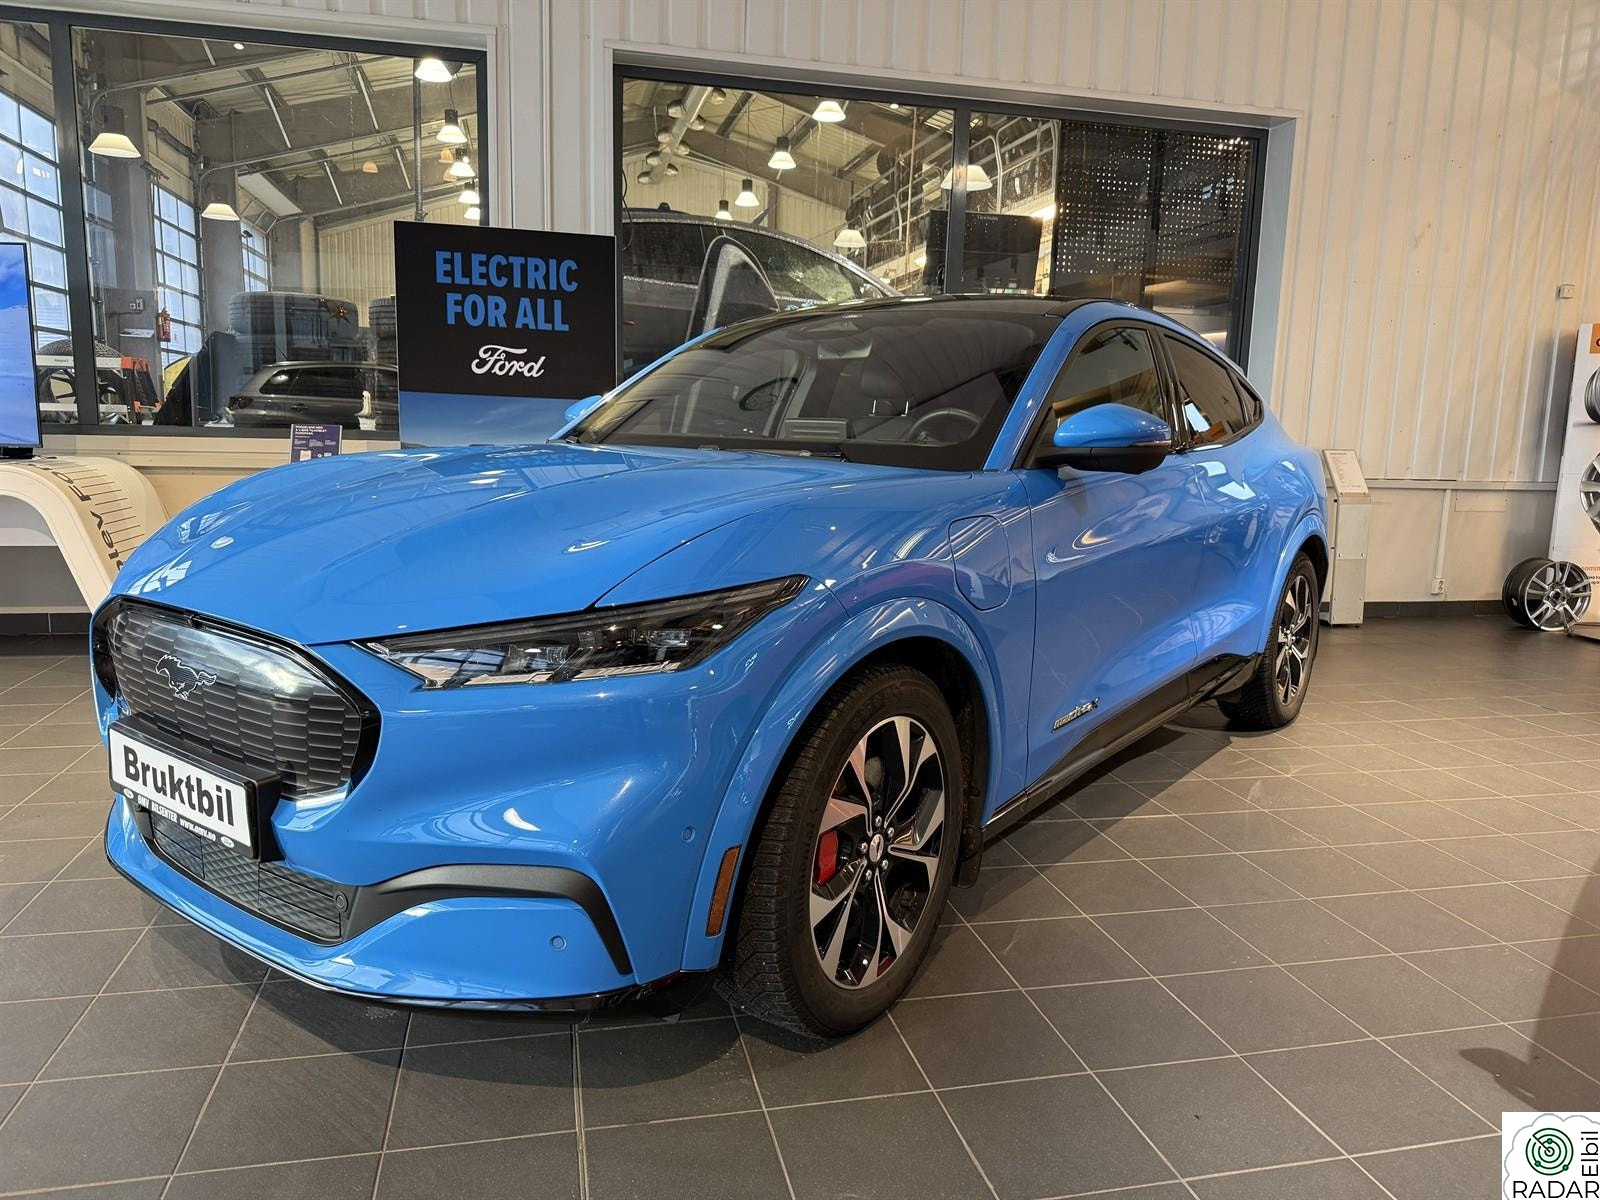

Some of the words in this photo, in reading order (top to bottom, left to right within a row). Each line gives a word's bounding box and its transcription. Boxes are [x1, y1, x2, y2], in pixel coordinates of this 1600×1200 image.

[435, 250, 579, 293] ELECTRIC
[446, 292, 508, 329] FOR
[515, 297, 570, 332] ALL
[471, 344, 547, 378] Ford
[123, 744, 235, 827] Bruktbil
